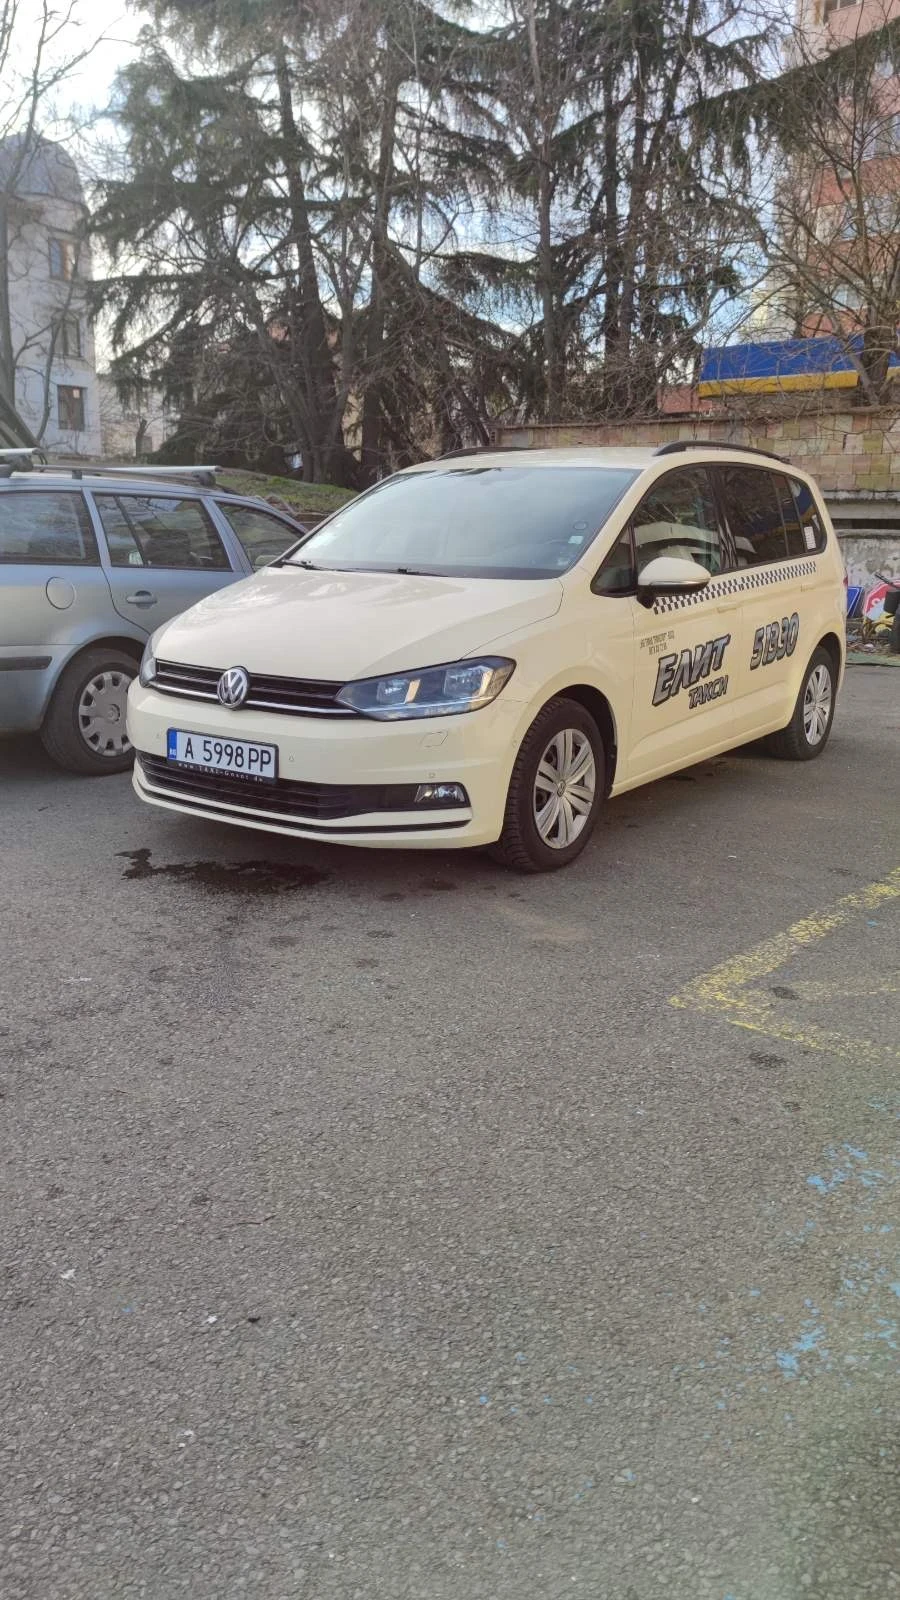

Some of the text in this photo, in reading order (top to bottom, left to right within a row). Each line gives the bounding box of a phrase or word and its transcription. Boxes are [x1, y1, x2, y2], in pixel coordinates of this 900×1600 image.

[750, 612, 799, 670] 51330
[652, 633, 731, 706] ЕЛИТ
[688, 675, 728, 709] ТАКСИ
[185, 737, 194, 759] A
